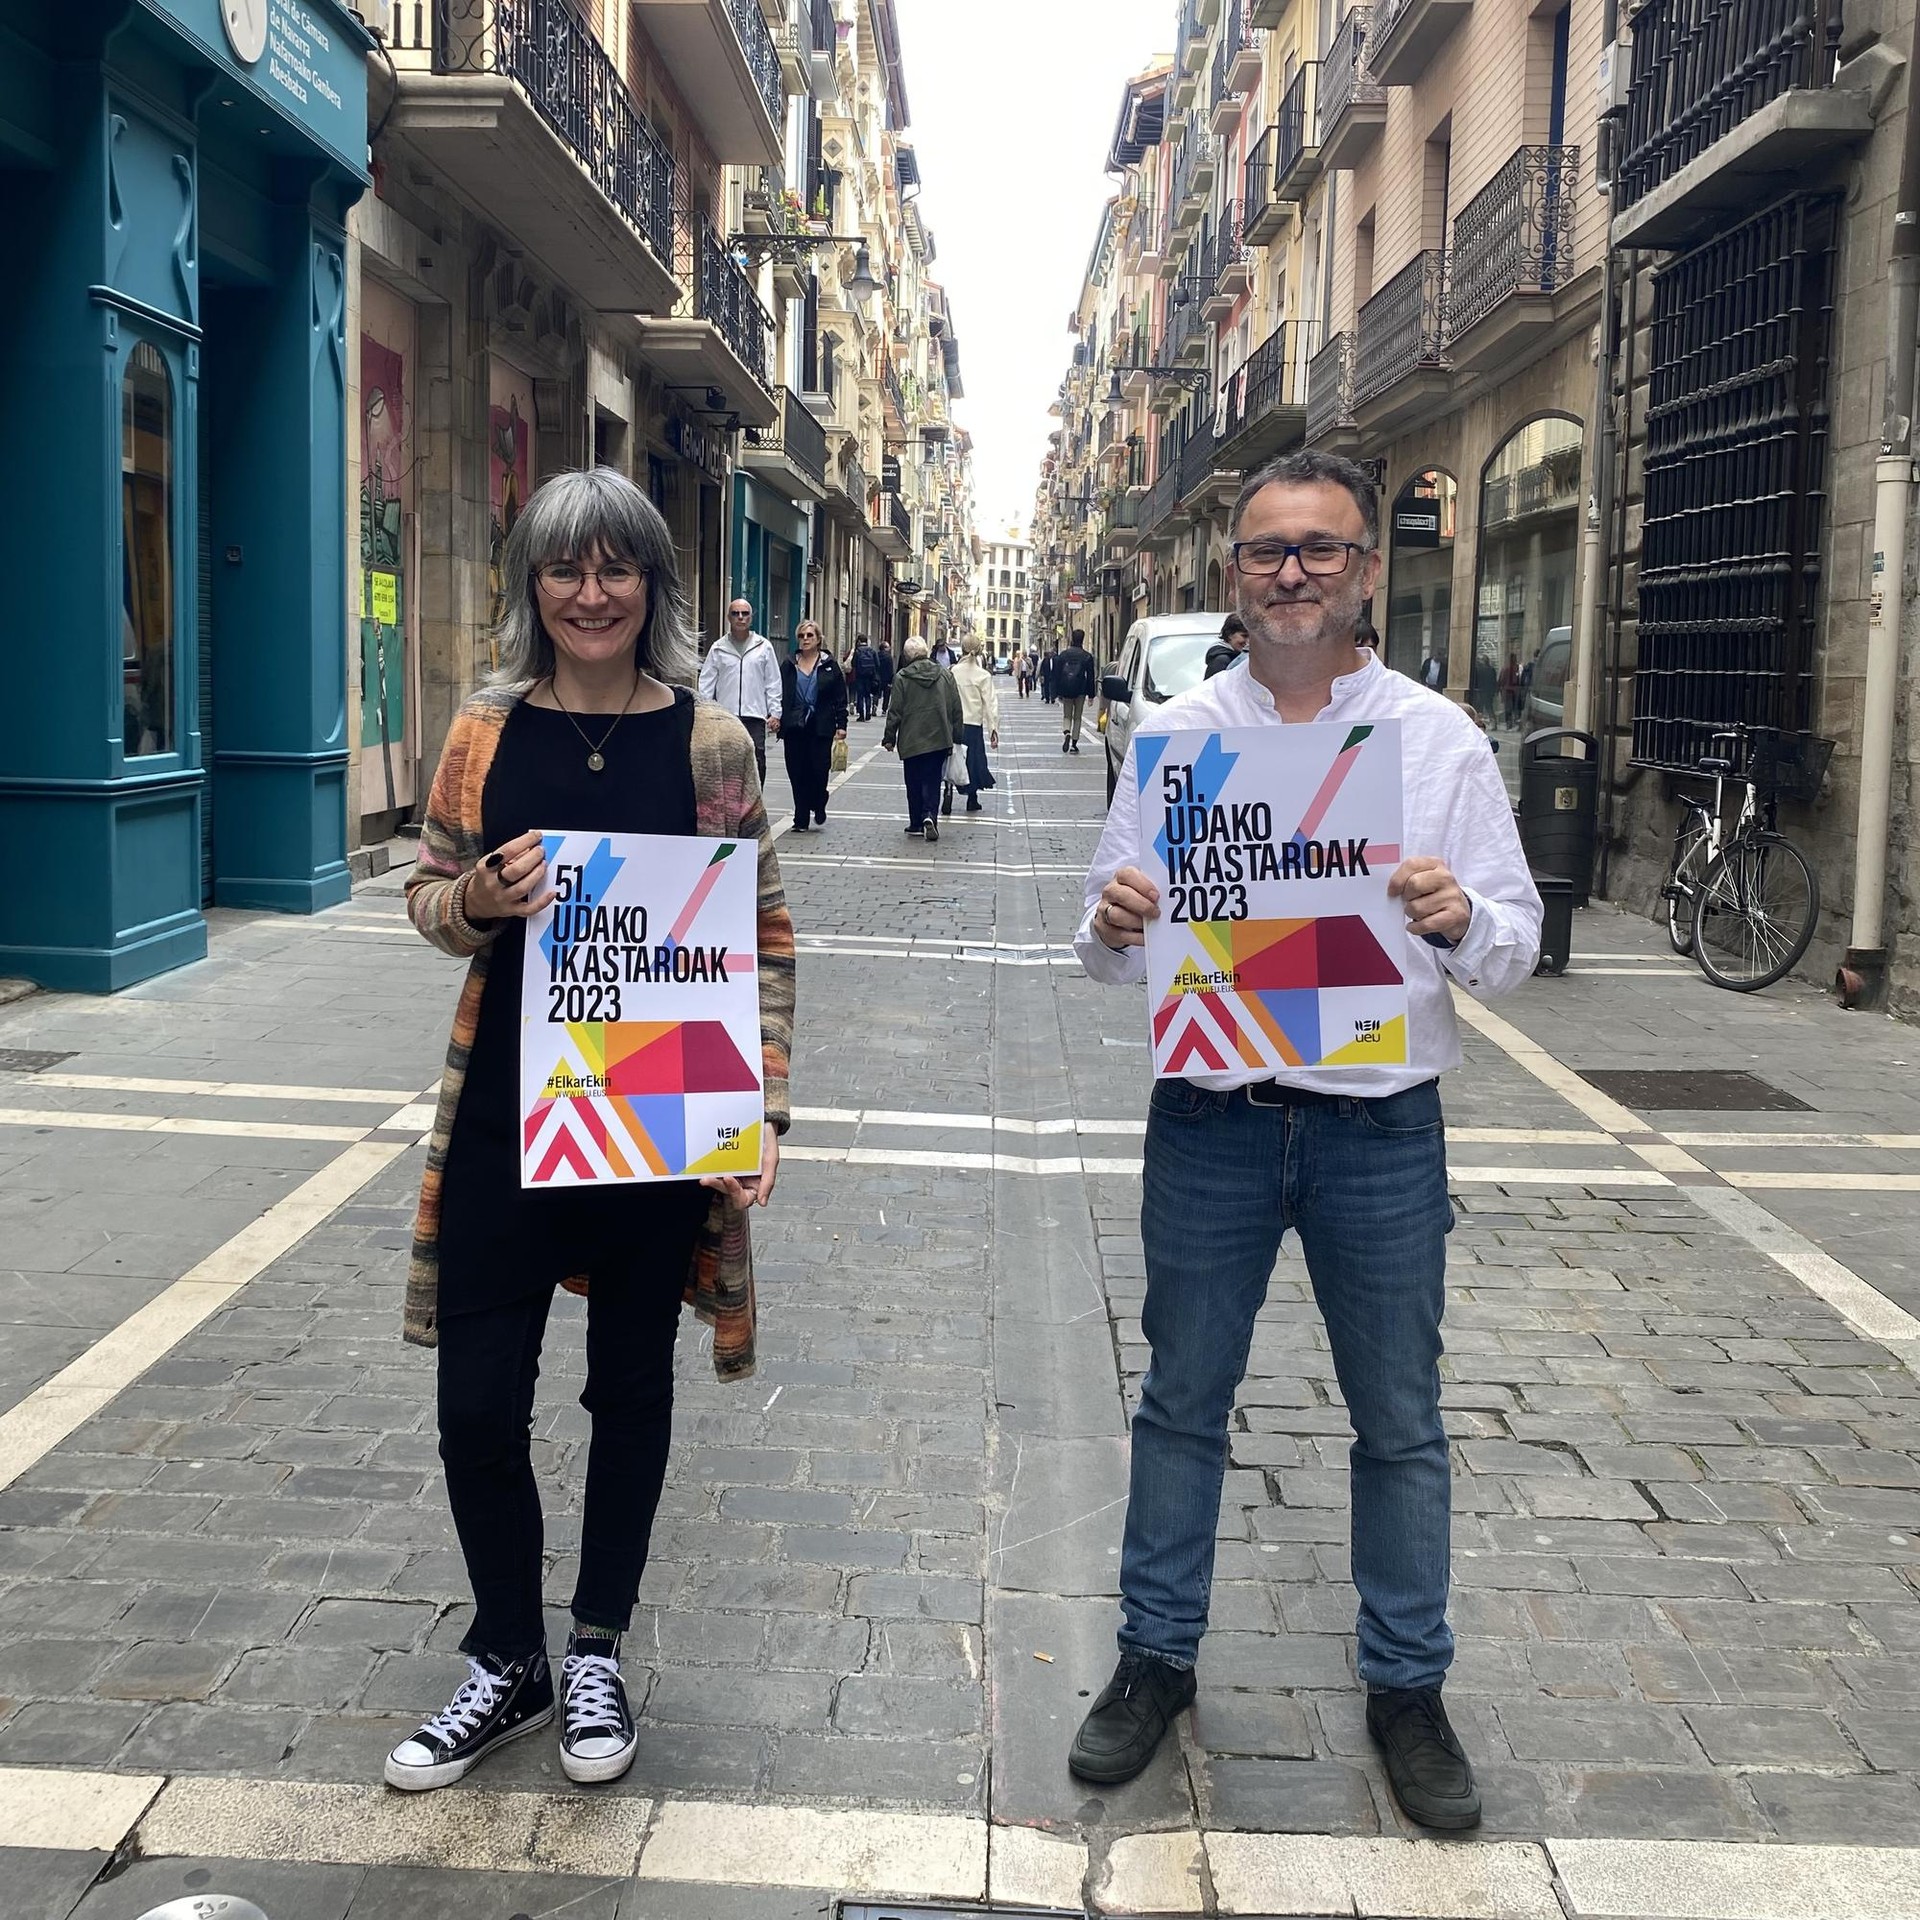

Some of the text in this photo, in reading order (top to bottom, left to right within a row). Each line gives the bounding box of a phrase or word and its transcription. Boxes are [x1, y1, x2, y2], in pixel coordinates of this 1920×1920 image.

[269, 6, 311, 59] de Navarra
[290, 1, 300, 25] de
[301, 12, 330, 53] Cámara
[269, 31, 342, 110] Nafarroako Ganbera
[269, 57, 308, 105] Abesbatza
[1163, 764, 1205, 804] 51.
[1165, 802, 1272, 846] UDAKO
[1167, 838, 1370, 885] IKASTAROAK
[555, 864, 592, 903] 51.
[552, 904, 648, 943] UDAKO
[1168, 884, 1249, 924] 2023
[550, 944, 730, 983] IKASTAROAK
[1174, 970, 1241, 986] #ElkarEkin
[547, 984, 622, 1023] 2023
[1182, 984, 1236, 994] WWW.UEU.EUS
[547, 1074, 612, 1089] #ElkarEkin
[554, 1089, 607, 1098] WWW.UEU.EUS
